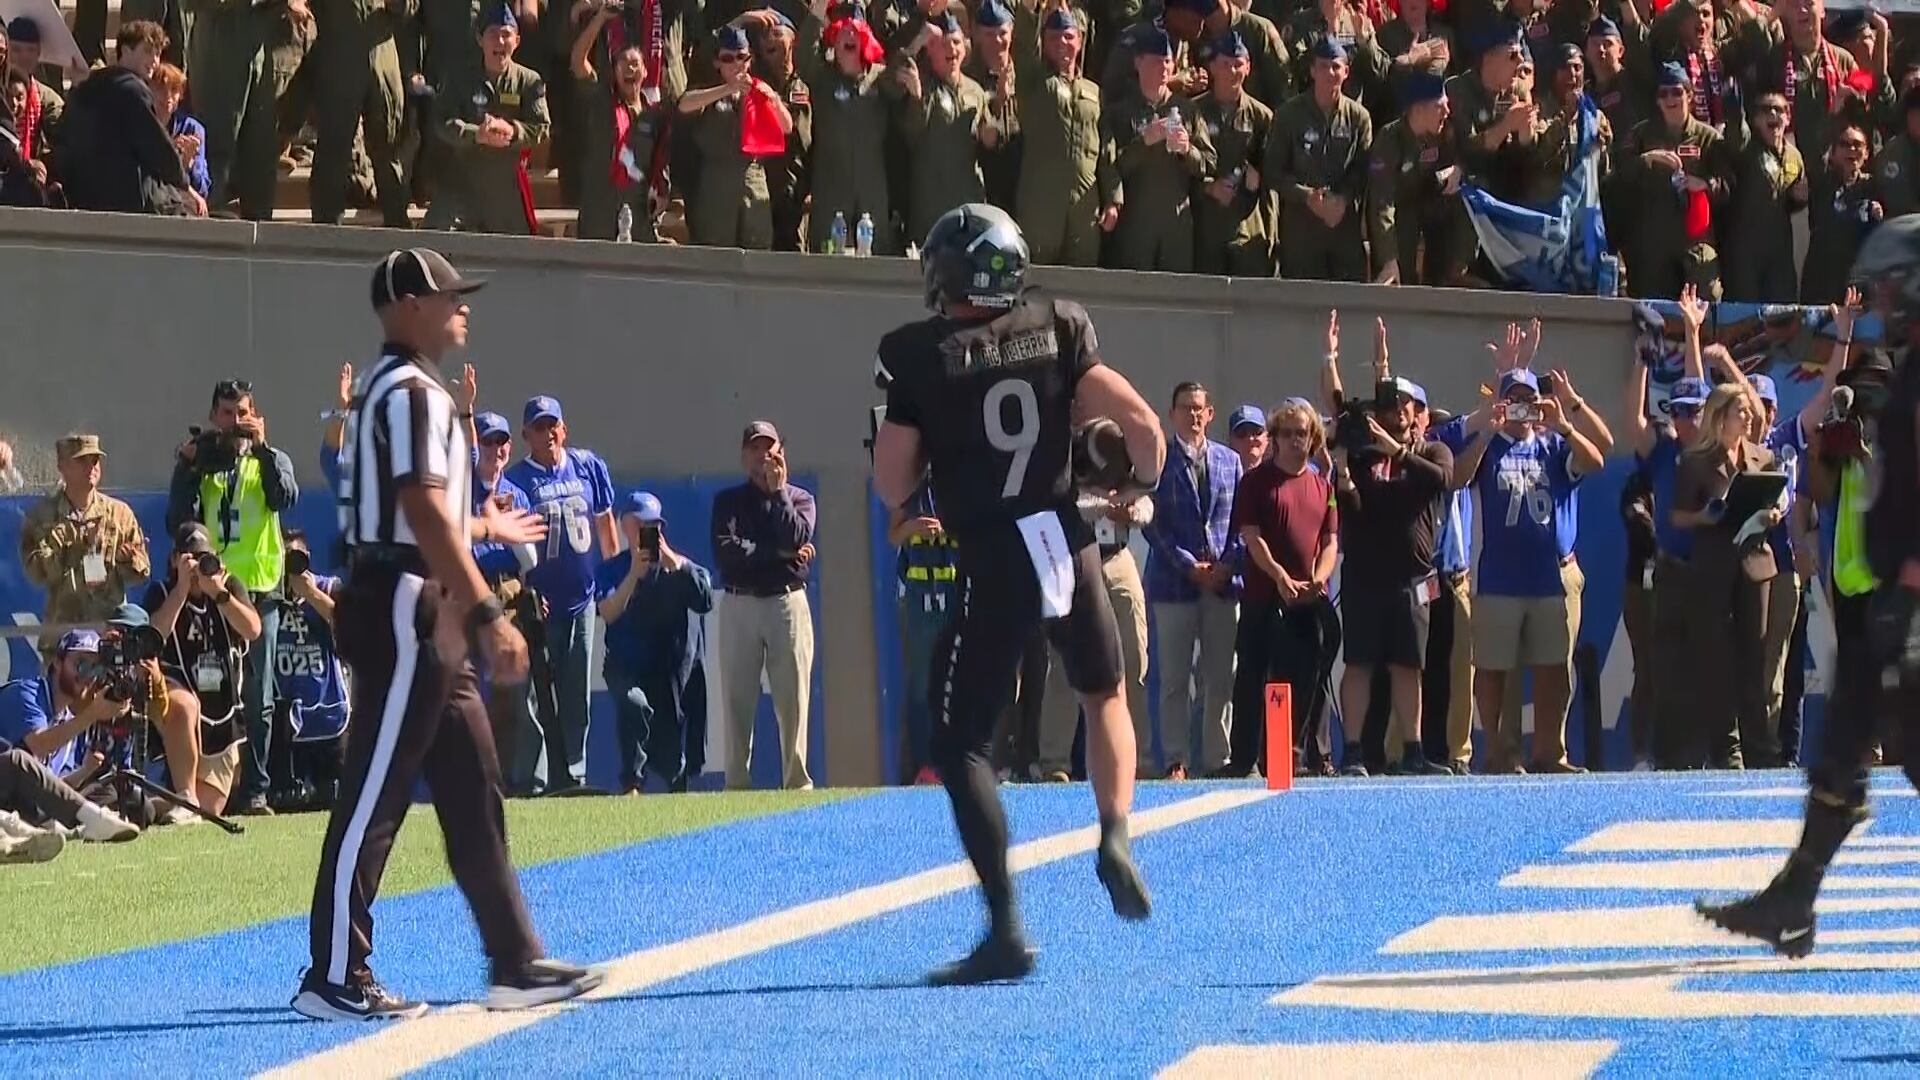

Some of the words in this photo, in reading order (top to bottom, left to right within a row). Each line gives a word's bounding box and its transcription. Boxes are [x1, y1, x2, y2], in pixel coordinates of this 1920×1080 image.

[983, 378, 1041, 499] 9
[535, 495, 592, 561] 76
[1497, 471, 1552, 527] 76
[277, 651, 325, 677] 025
